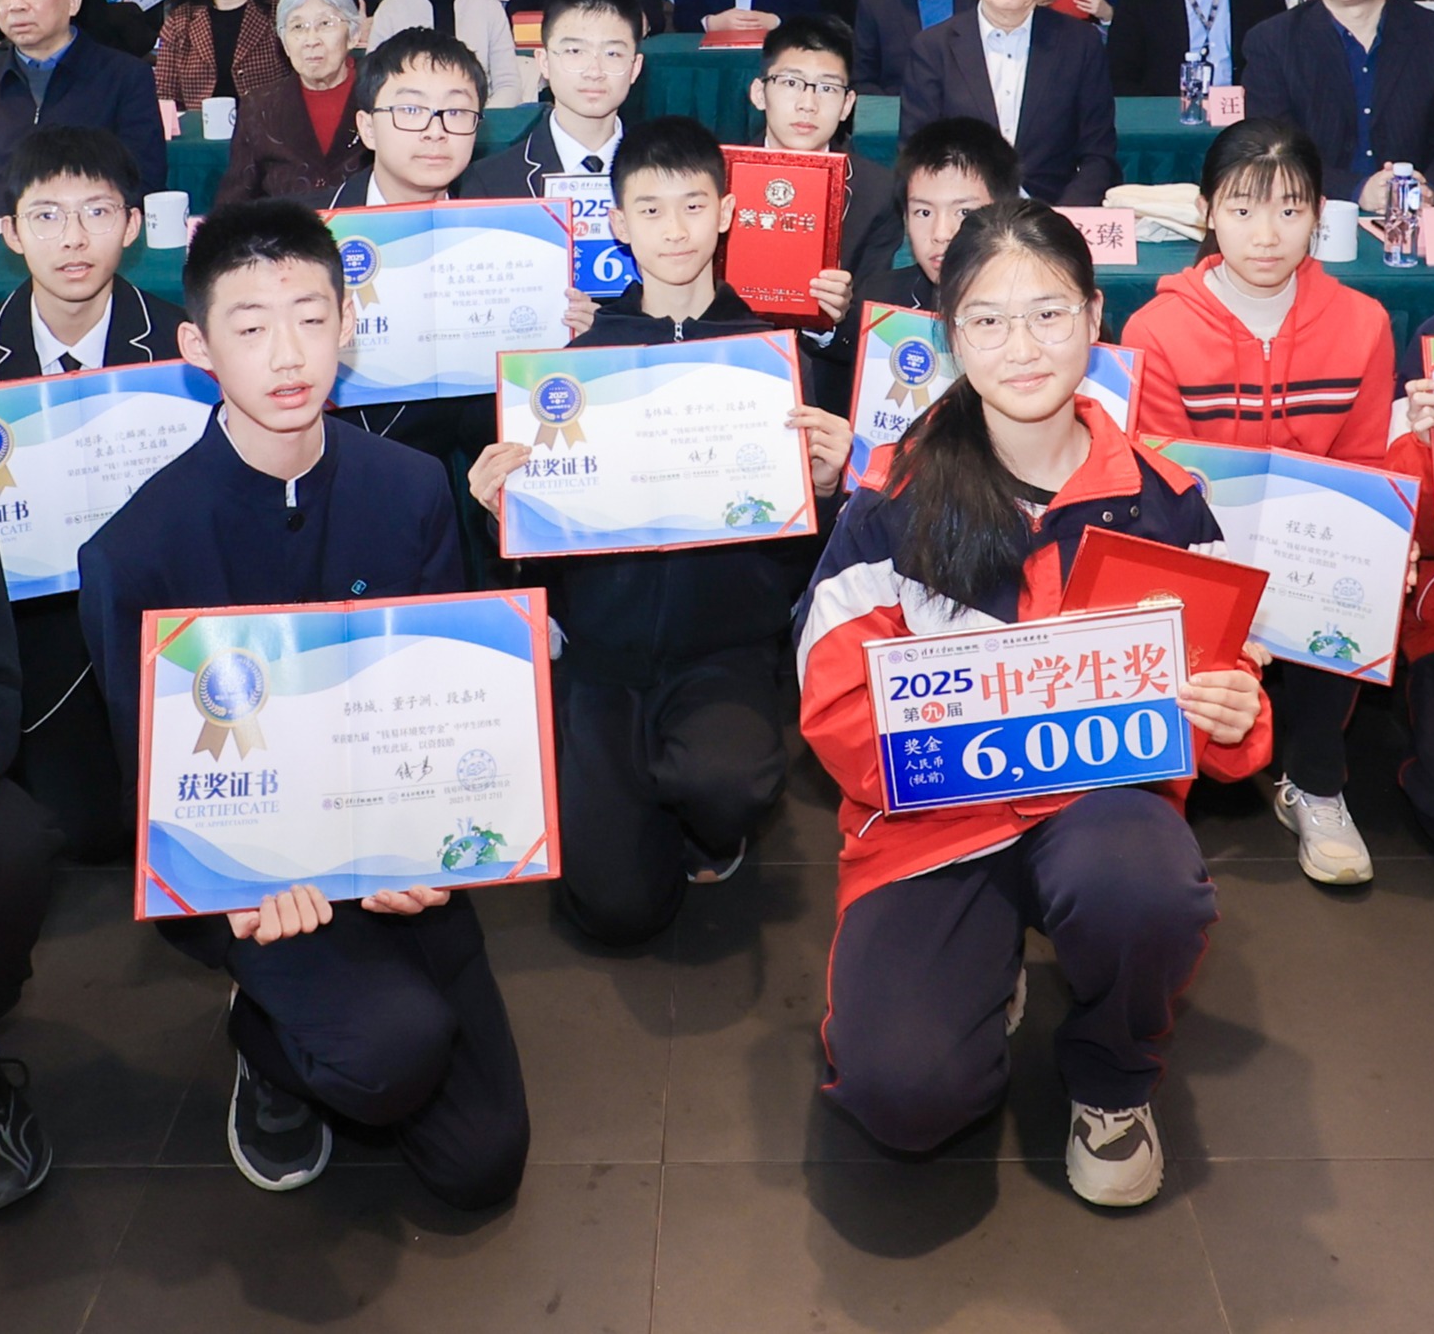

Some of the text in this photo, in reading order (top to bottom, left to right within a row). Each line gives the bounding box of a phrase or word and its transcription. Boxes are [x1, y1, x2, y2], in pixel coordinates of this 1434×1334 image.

[572, 199, 611, 218] 025
[573, 221, 601, 236] 九届
[356, 316, 389, 335] 证书
[524, 455, 598, 478] 获奖证书
[522, 476, 600, 490] CERTIFICATE
[889, 667, 974, 701] 2025
[981, 643, 1169, 715] 中学生奖
[903, 701, 963, 723] 第九届
[904, 735, 943, 756] 奖金
[961, 709, 1168, 781] 6,000
[905, 757, 944, 771] 人民币
[177, 768, 280, 801] 获奖证书
[174, 800, 280, 820] CERTIFICATE
